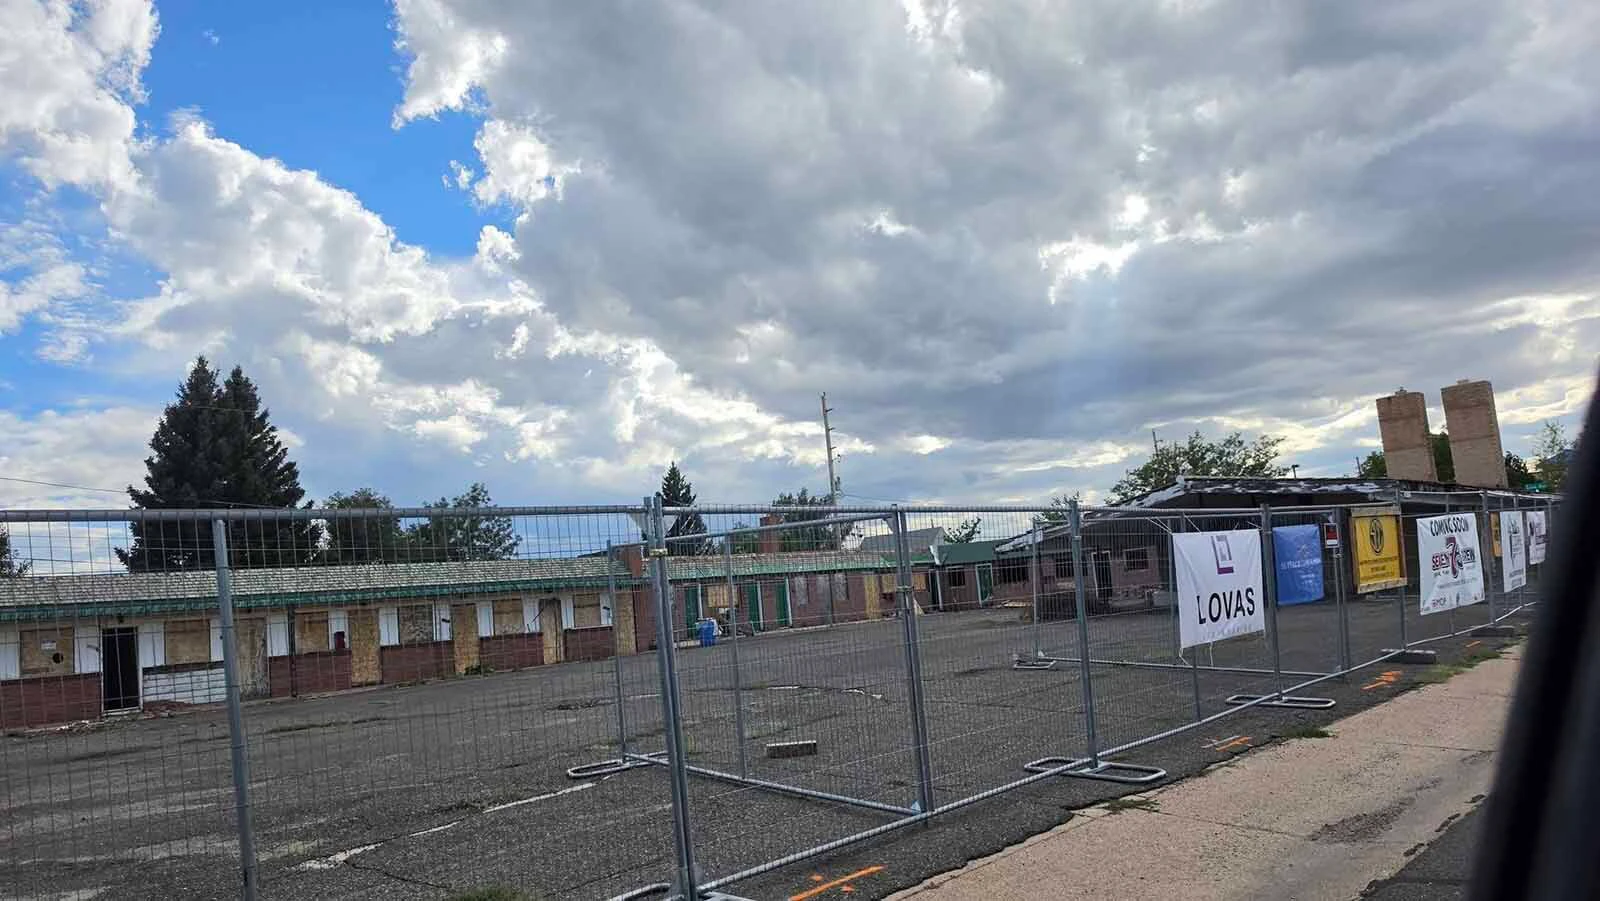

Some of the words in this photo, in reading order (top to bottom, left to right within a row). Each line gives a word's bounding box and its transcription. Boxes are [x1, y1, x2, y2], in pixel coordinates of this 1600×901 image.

[1430, 517, 1453, 537] COMING
[1453, 516, 1469, 533] SOON
[1196, 587, 1256, 625] LOVAS
